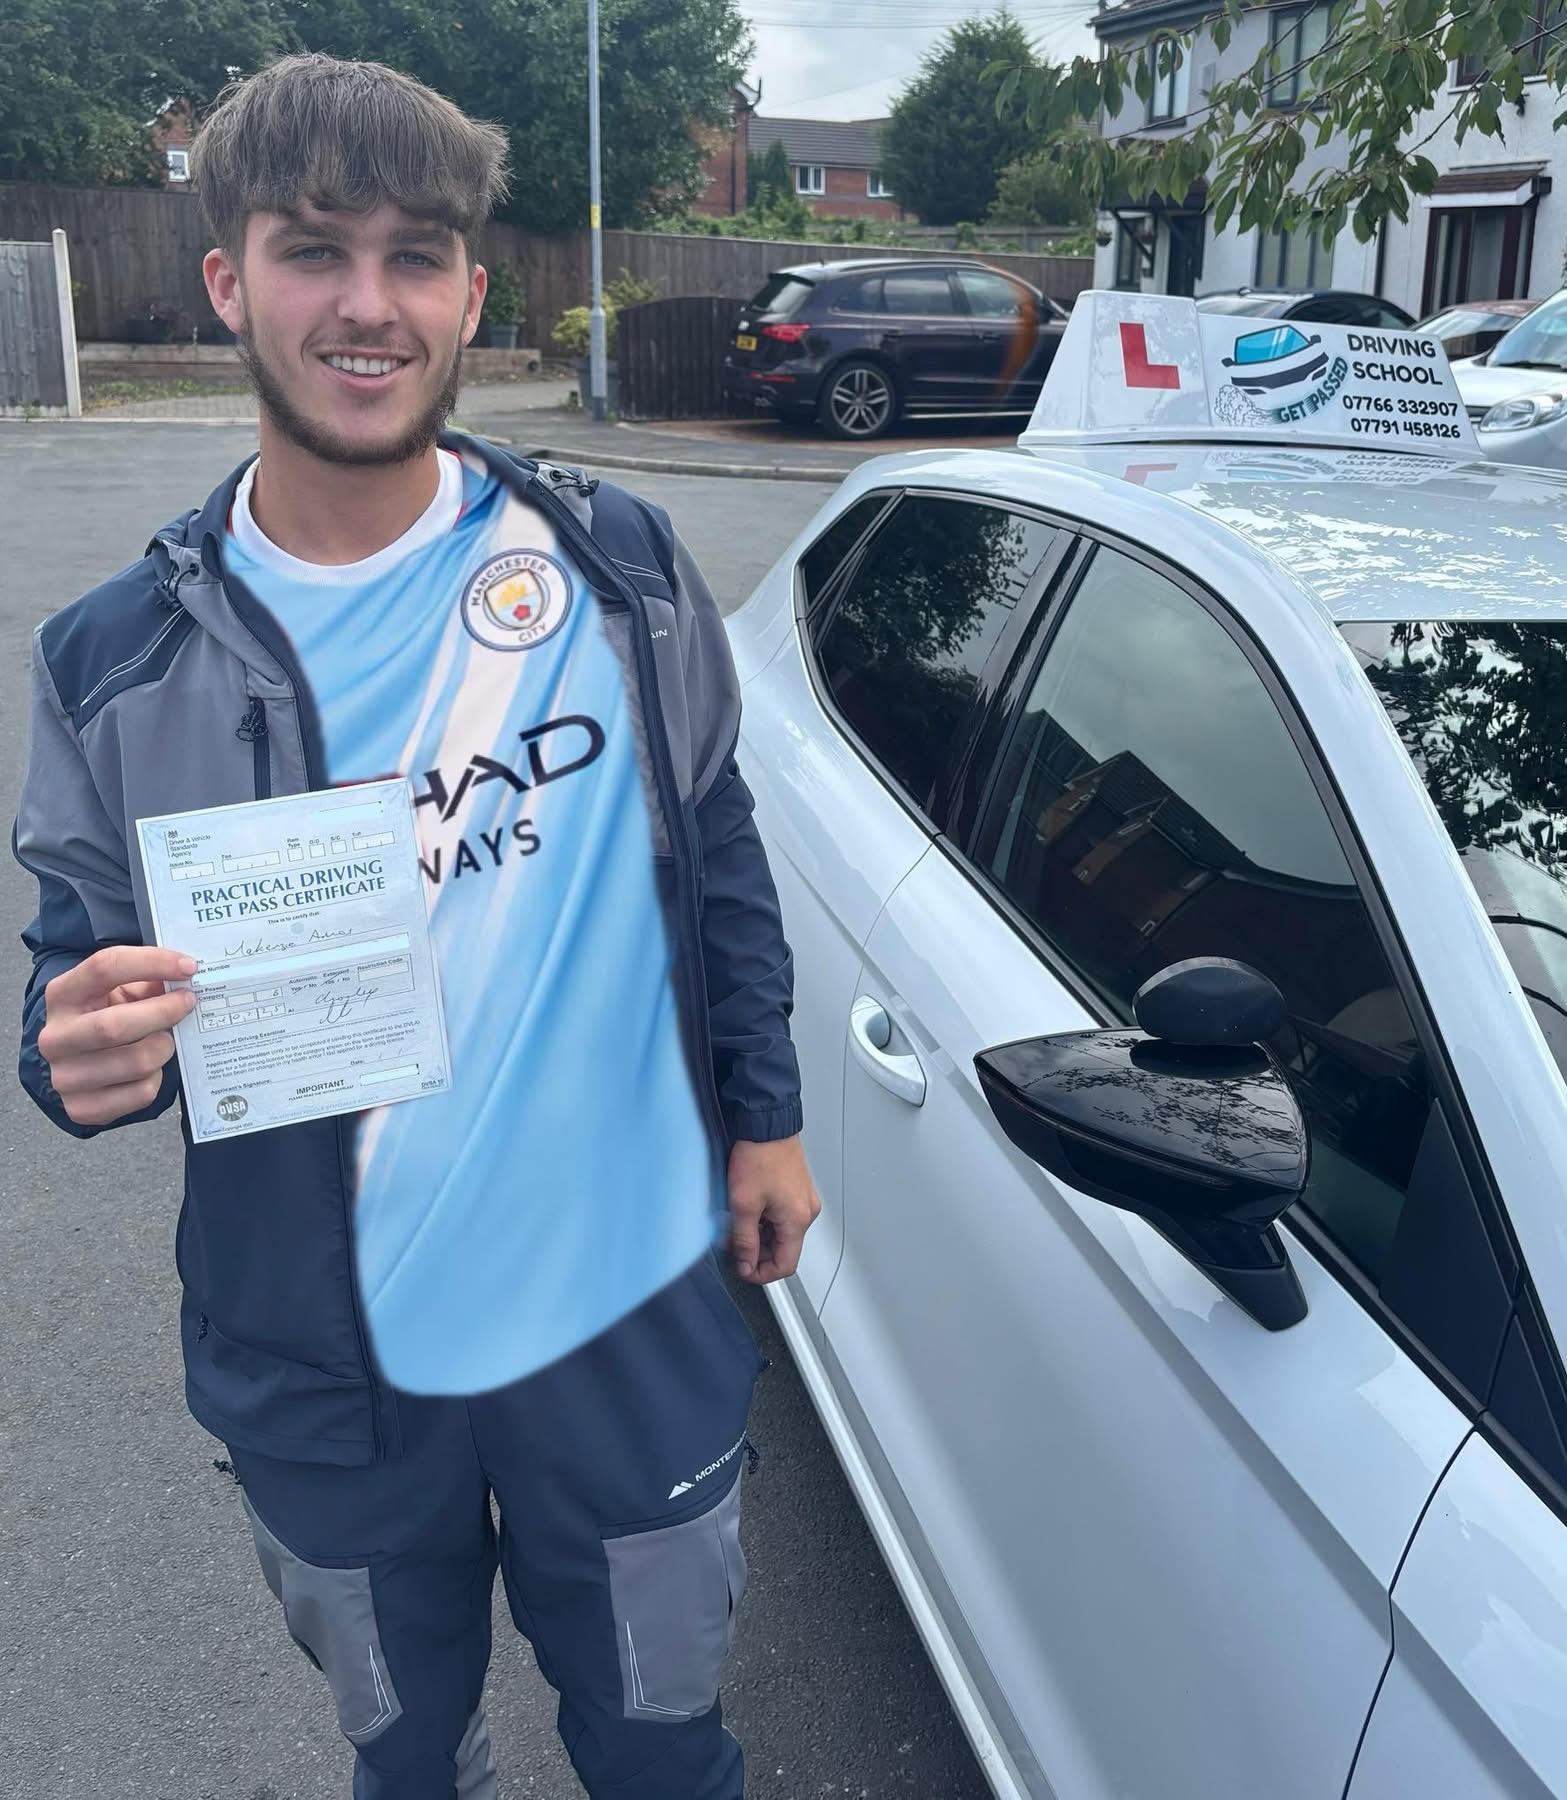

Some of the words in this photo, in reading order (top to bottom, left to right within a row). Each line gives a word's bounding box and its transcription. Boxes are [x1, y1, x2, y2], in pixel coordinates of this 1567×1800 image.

[1119, 322, 1180, 390] L
[1347, 334, 1436, 358] DRIVING
[1352, 361, 1443, 385] SCHOOL
[1277, 401, 1306, 423] GET
[1305, 356, 1348, 415] PASSED
[1343, 395, 1393, 412] 07766
[1397, 399, 1458, 417] 332907
[1351, 418, 1399, 435] 07791
[1403, 421, 1460, 438] 458126
[471, 557, 549, 607] MANCHESTER
[518, 621, 548, 643] CITY
[191, 875, 295, 906] PRACTICAL
[299, 860, 383, 887] DRIVING
[194, 905, 234, 923] TEST
[238, 897, 279, 915] PASS
[283, 878, 386, 908] CERTIFICATE
[296, 1081, 345, 1095] IMPORTANT
[219, 1101, 245, 1115] DVSA
[695, 1431, 747, 1481] MONTERR
